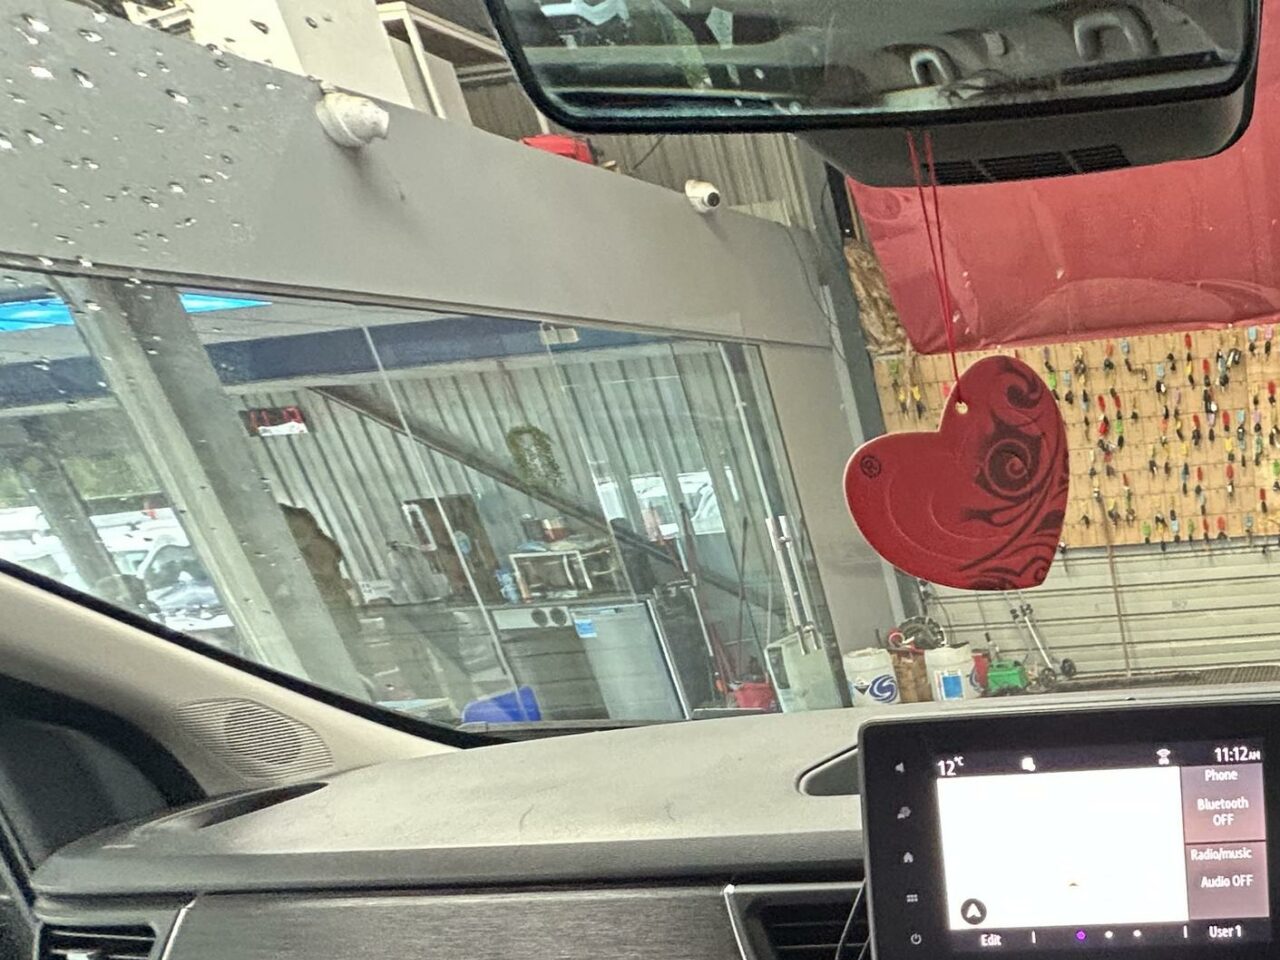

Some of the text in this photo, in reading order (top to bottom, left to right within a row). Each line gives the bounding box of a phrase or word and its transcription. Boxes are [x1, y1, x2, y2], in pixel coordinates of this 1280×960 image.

[1204, 768, 1239, 782] Phone
[1197, 796, 1250, 811] Bluetooth
[1212, 813, 1235, 826] OFF
[1190, 847, 1253, 861] Radio/music
[1200, 874, 1254, 888] Audio OFF
[1208, 924, 1242, 938] User 1
[980, 933, 1002, 946] Edit
